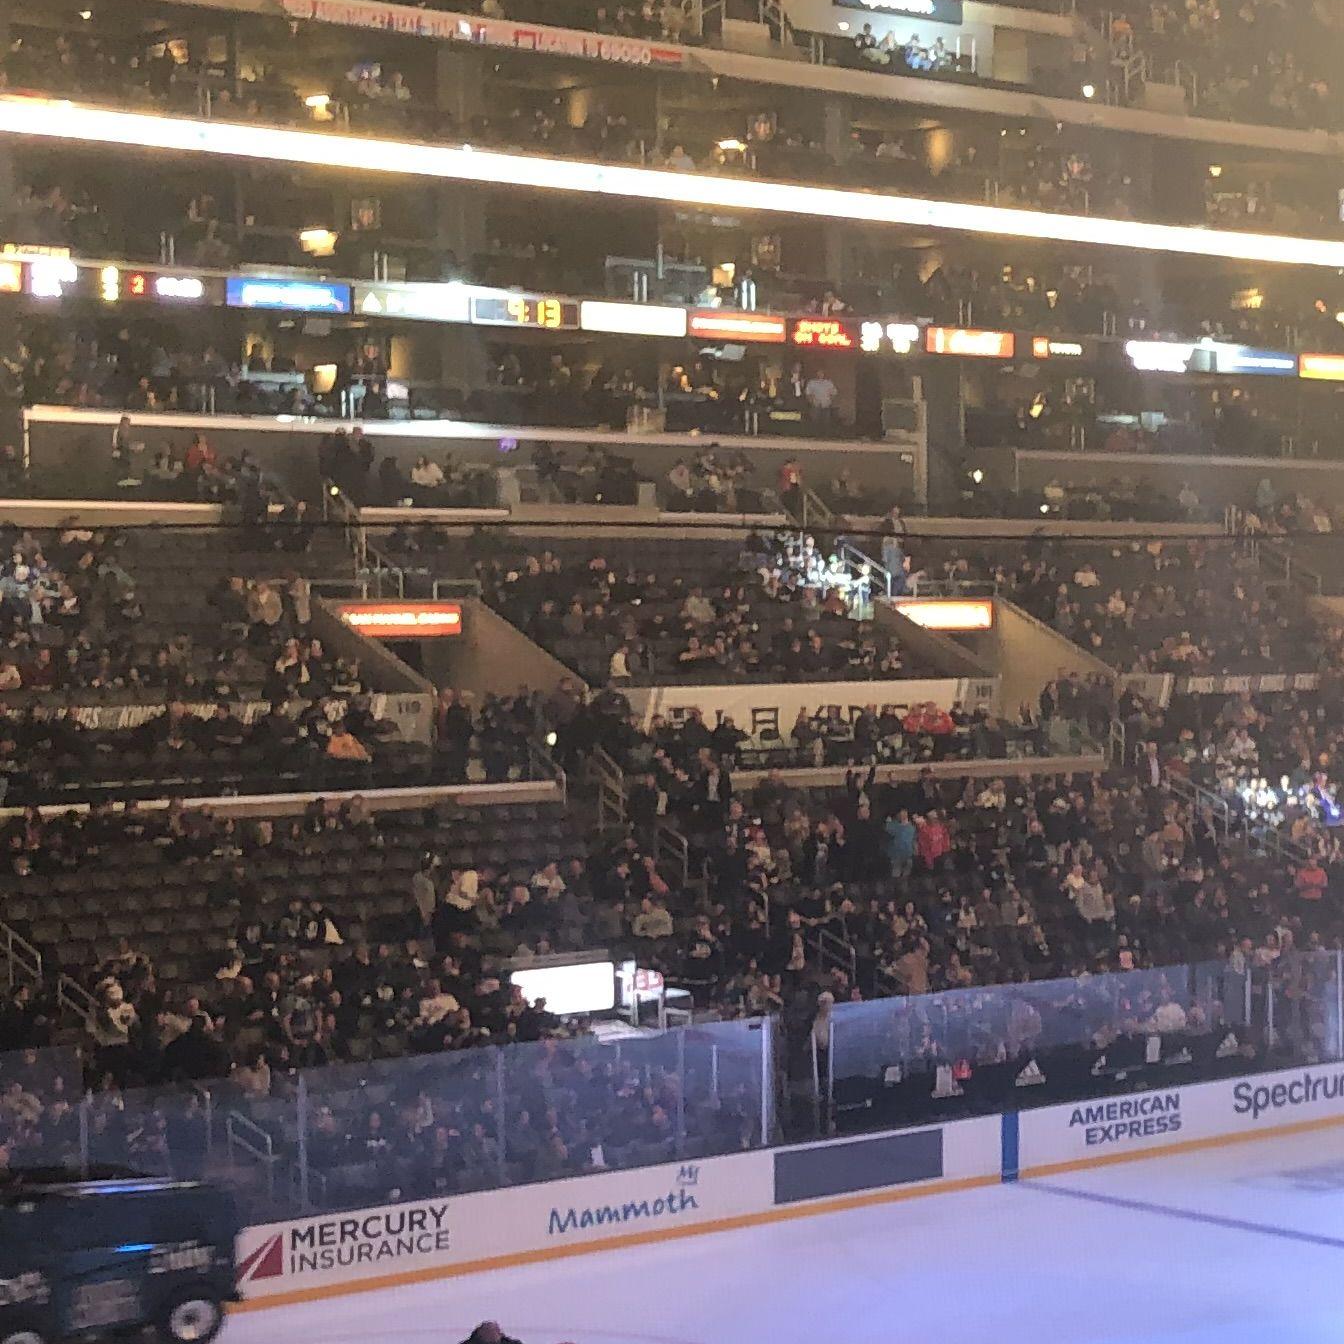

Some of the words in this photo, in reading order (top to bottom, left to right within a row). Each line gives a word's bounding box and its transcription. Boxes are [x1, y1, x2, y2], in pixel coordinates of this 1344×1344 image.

[1069, 1093, 1180, 1127] AMERICAN
[1085, 1112, 1181, 1145] EXPRESS
[290, 1205, 449, 1250] MERCURY
[547, 1189, 699, 1236] Mammoth
[291, 1230, 450, 1274] INSURANCE
